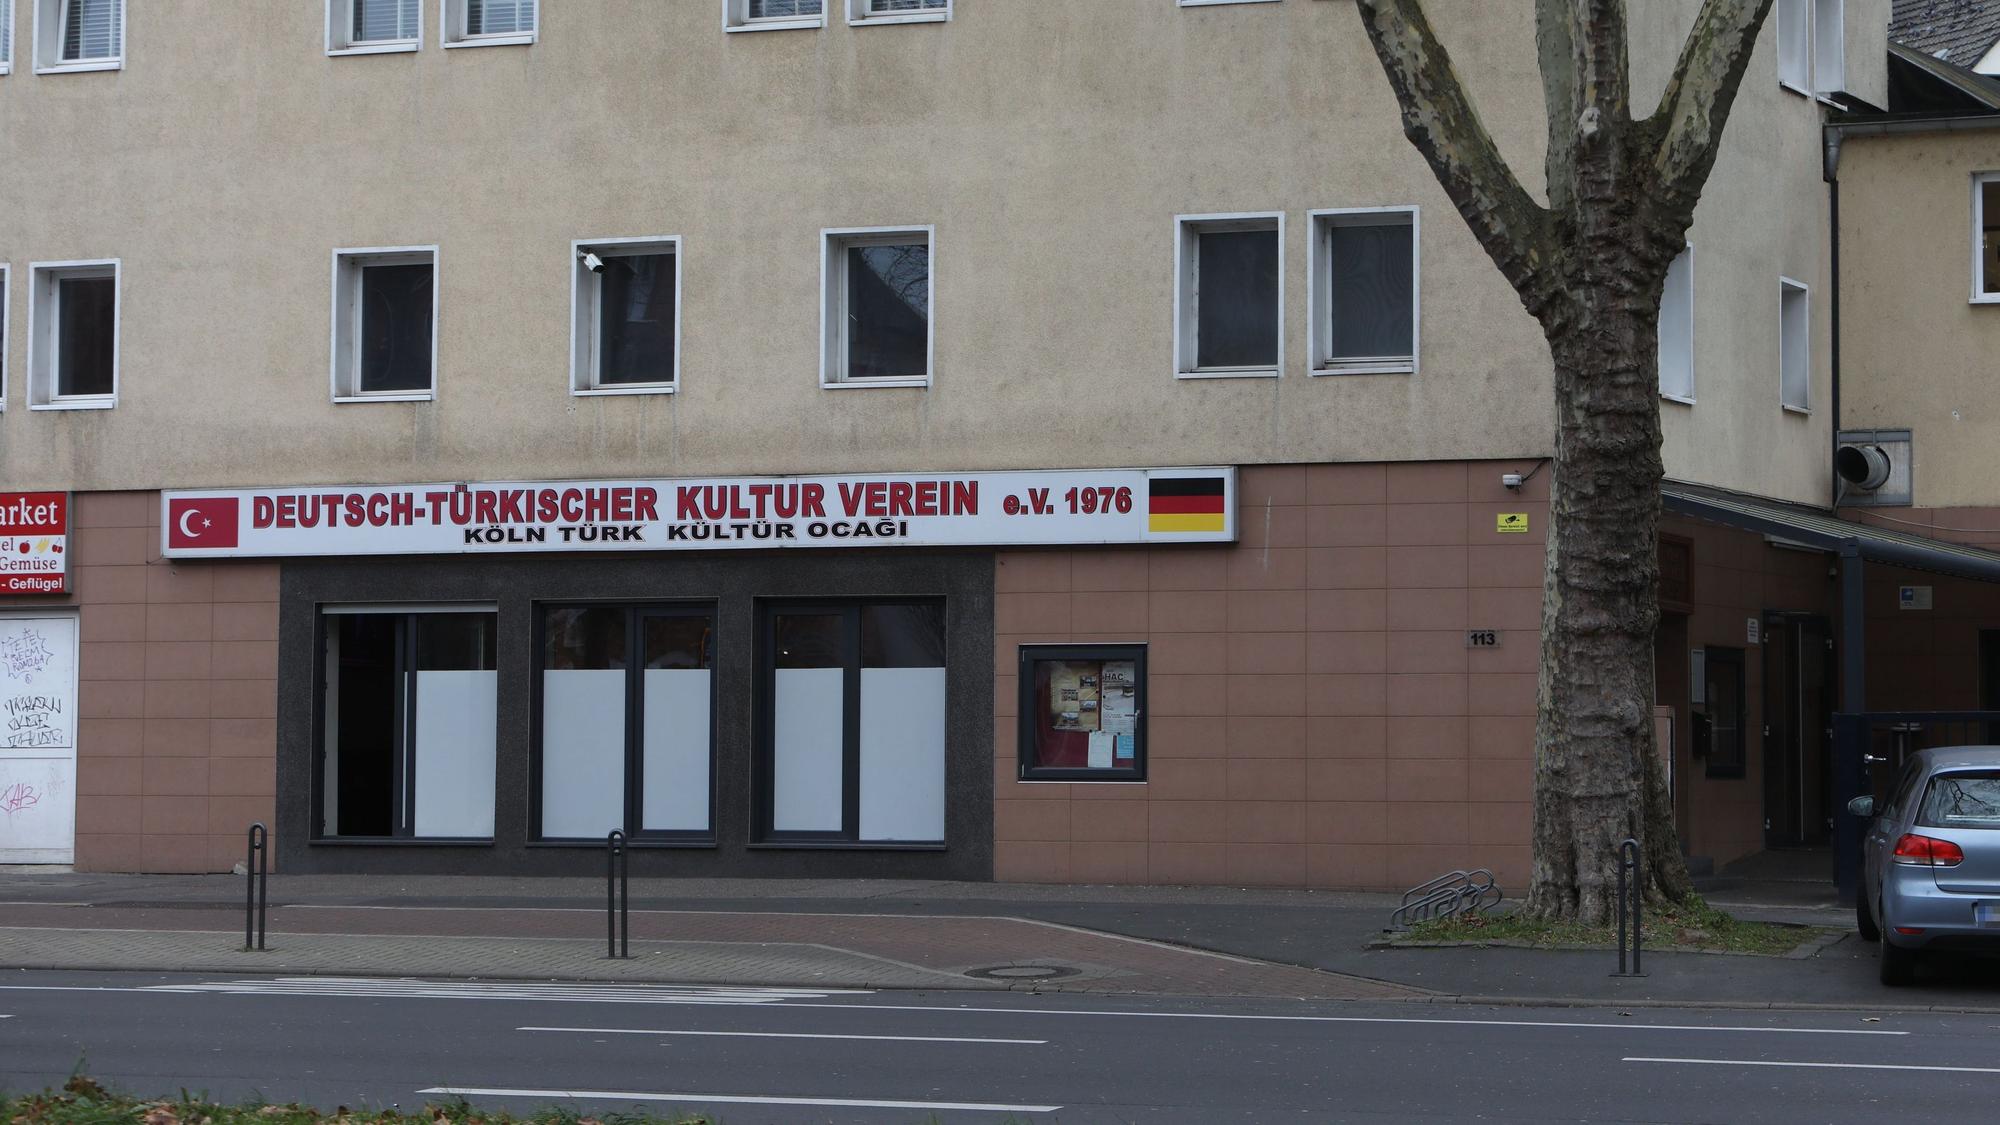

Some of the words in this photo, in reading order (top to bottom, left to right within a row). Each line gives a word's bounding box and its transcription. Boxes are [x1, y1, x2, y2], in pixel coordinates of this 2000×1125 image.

[253, 484, 658, 528] DEUTSCH-TÜRKISCHER
[676, 483, 825, 520] KULTUR
[837, 481, 979, 517] VEREIN
[1002, 487, 1054, 515] e.V.
[1064, 486, 1132, 514] 1976
[465, 524, 546, 544] KÖLN
[558, 522, 645, 542] TÜRK
[668, 519, 795, 541] KÜLTÜR
[807, 517, 908, 538] OCAĞI
[0, 556, 57, 571] Gemüse
[9, 577, 63, 591] Geflügel
[1470, 633, 1495, 645] 113
